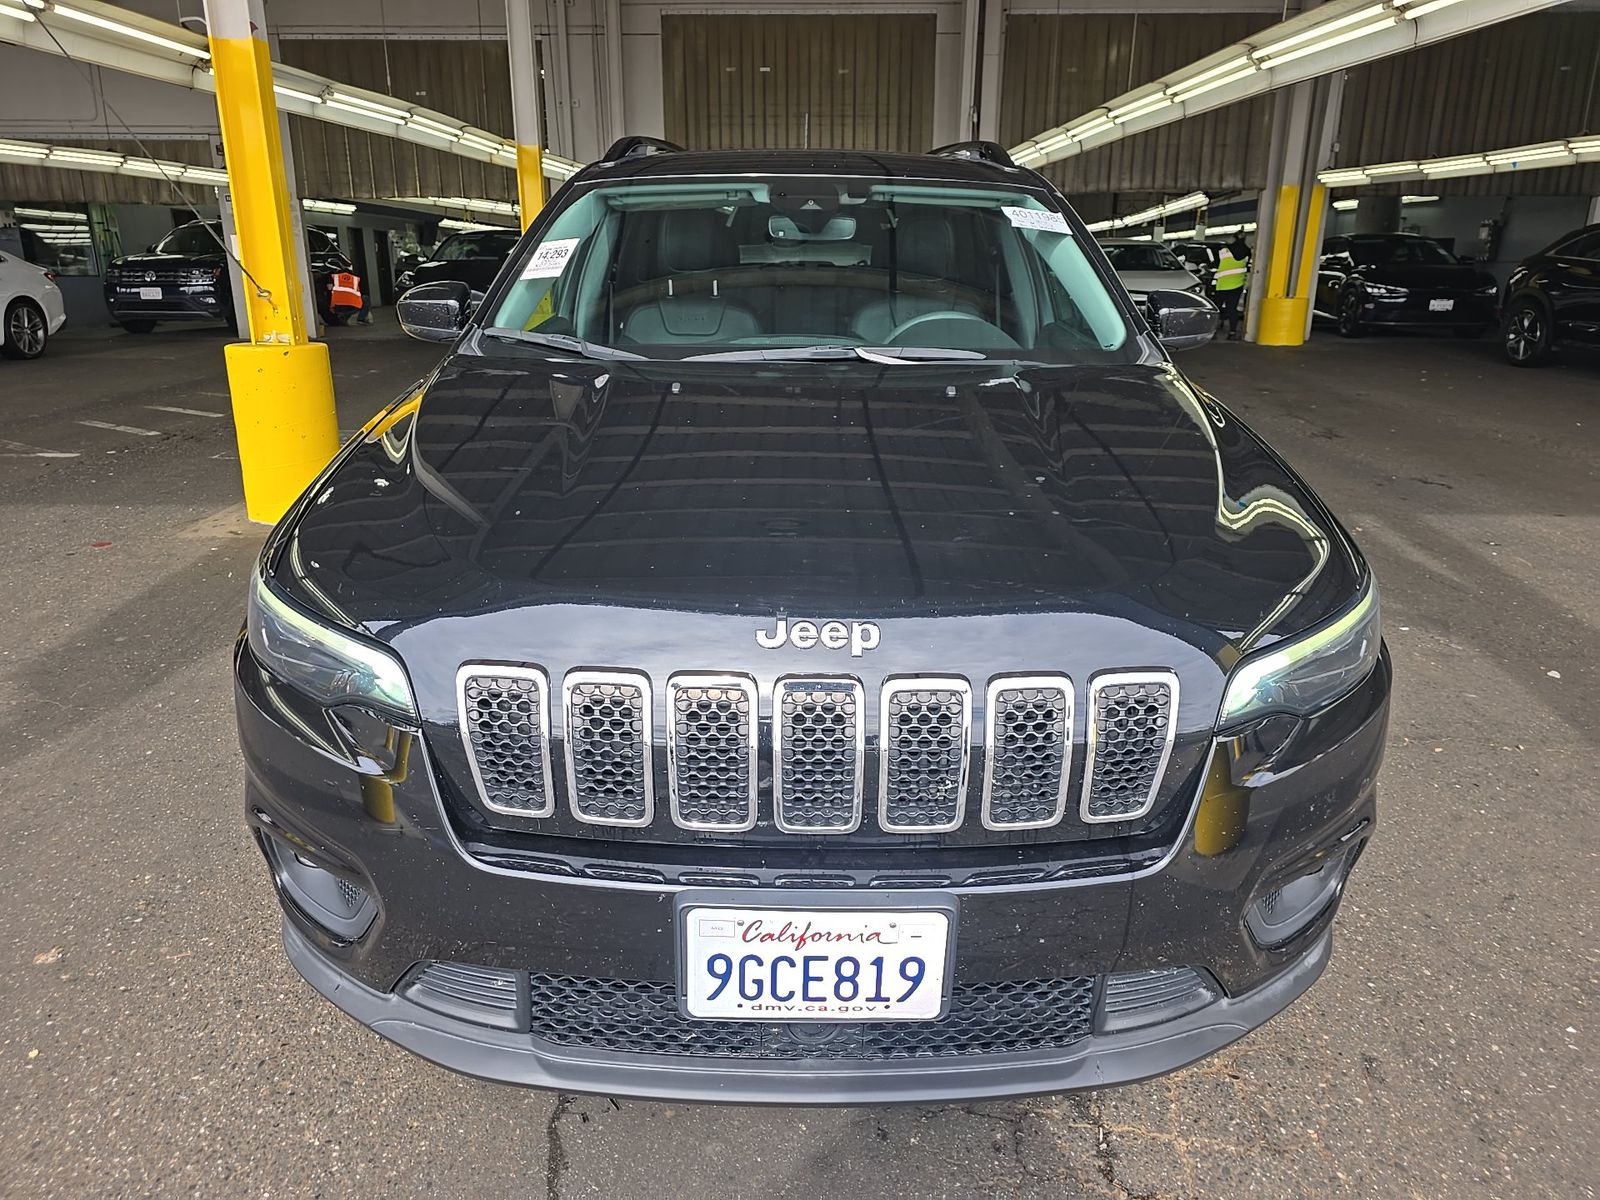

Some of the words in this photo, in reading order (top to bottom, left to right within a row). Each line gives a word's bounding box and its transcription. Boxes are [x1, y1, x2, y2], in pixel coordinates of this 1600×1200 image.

[755, 611, 882, 658] Jeep
[741, 919, 898, 951] California
[706, 952, 927, 1003] 9GCE819
[750, 1003, 877, 1014] dmv.ca.gov
